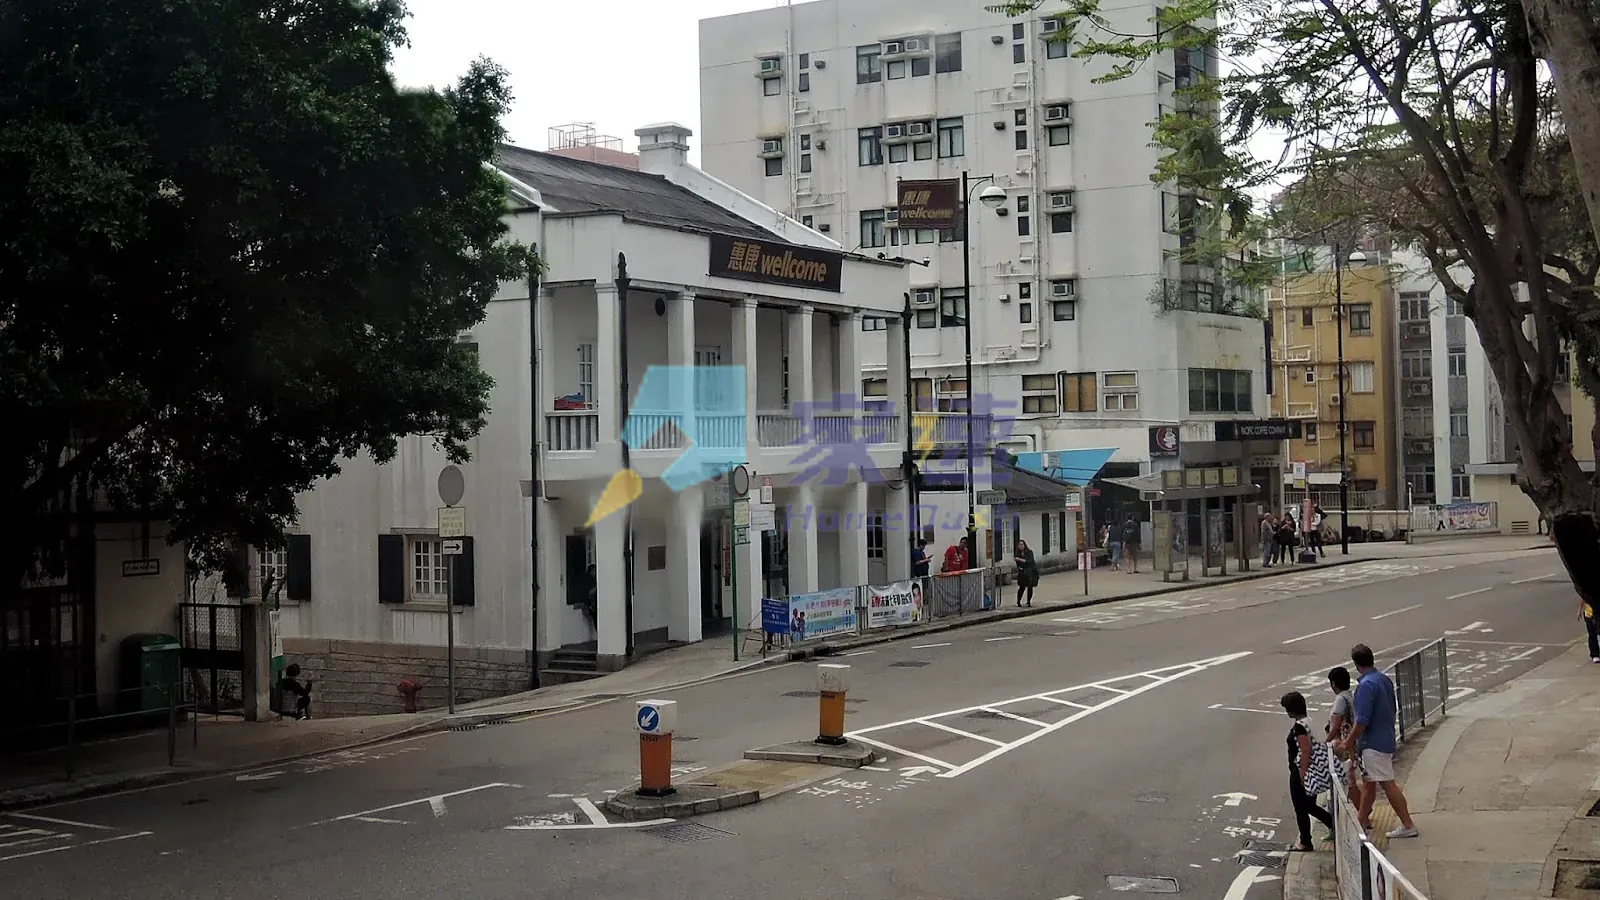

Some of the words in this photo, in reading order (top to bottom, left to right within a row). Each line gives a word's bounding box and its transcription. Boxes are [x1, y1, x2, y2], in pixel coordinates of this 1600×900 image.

[900, 206, 954, 219] wellcome
[728, 241, 761, 272] 惠康
[761, 250, 827, 282] wellcome
